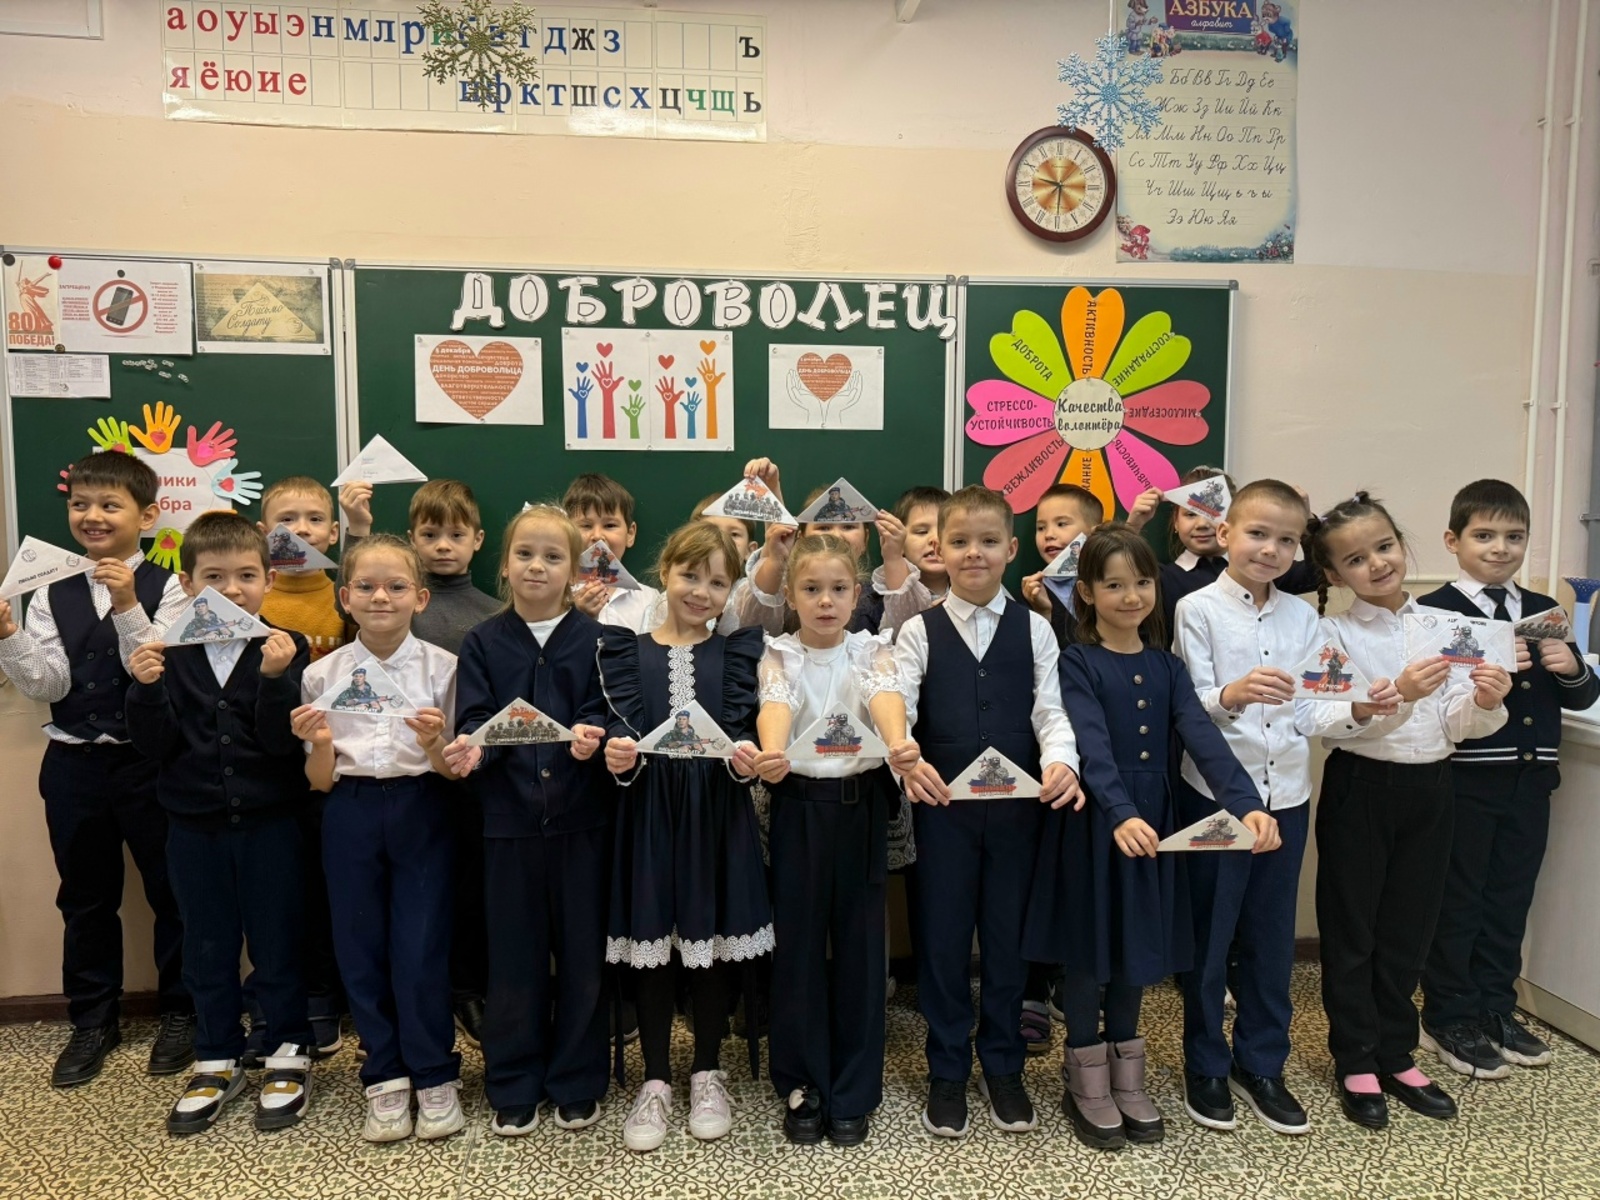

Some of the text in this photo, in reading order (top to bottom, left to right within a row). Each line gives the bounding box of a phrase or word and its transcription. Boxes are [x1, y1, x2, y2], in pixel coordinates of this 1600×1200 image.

[1169, 0, 1253, 18] АЗБУКА
[167, 7, 187, 30] а
[197, 9, 218, 32] о
[225, 10, 248, 41] у
[253, 13, 279, 35] ы
[286, 14, 305, 37] э
[312, 15, 335, 38] н
[343, 17, 369, 42] м
[373, 20, 396, 43] л
[402, 20, 425, 54] р
[738, 36, 761, 58] ъ
[169, 66, 190, 89] я
[200, 61, 219, 90] ё
[224, 68, 253, 92] ю
[257, 70, 281, 93] и
[288, 72, 307, 95] е
[519, 83, 541, 105] к
[1170, 68, 1195, 85] Бб
[1192, 69, 1212, 86] Вв
[1236, 71, 1255, 93] Дд
[1260, 72, 1275, 88] Ее
[1192, 98, 1209, 119] Зз
[1214, 98, 1235, 115] Ии
[1262, 100, 1282, 116] Кк
[1153, 124, 1186, 141] Мм
[1190, 125, 1212, 142] Нн
[1216, 126, 1234, 142] Оо
[1238, 127, 1263, 144] Пп
[1266, 128, 1286, 150] Рр
[1129, 152, 1287, 176] Сс Тт Уу Фф Хх Цц
[1168, 180, 1195, 196] Шш
[1201, 181, 1231, 201] Щщ
[1166, 209, 1237, 225] Ээ Юю Яя
[450, 272, 956, 340] ДОБРОВОЛЕЦ
[8, 312, 34, 331] 80
[9, 335, 55, 346] ПОБЕДА!
[1082, 300, 1097, 376] АКТИВНОСТЬ
[1011, 338, 1053, 381] ДОБРОТА
[1114, 332, 1171, 387] СОСТРАДАНИЕ
[432, 364, 522, 376] ДЕНЬ ДОБРОВОЛЬЦА
[987, 400, 1037, 411] СТРЕССО-
[1058, 397, 1122, 413] Качества
[1129, 408, 1199, 418] МИЛОСЕРДИЕ
[970, 416, 1054, 431] УСТОЙЧИВОСТЬ
[1058, 418, 1121, 433] волонтёра
[1003, 438, 1064, 495] ВЕЖЛИВОСТЬ
[158, 476, 196, 487] ики
[156, 496, 192, 514] бра
